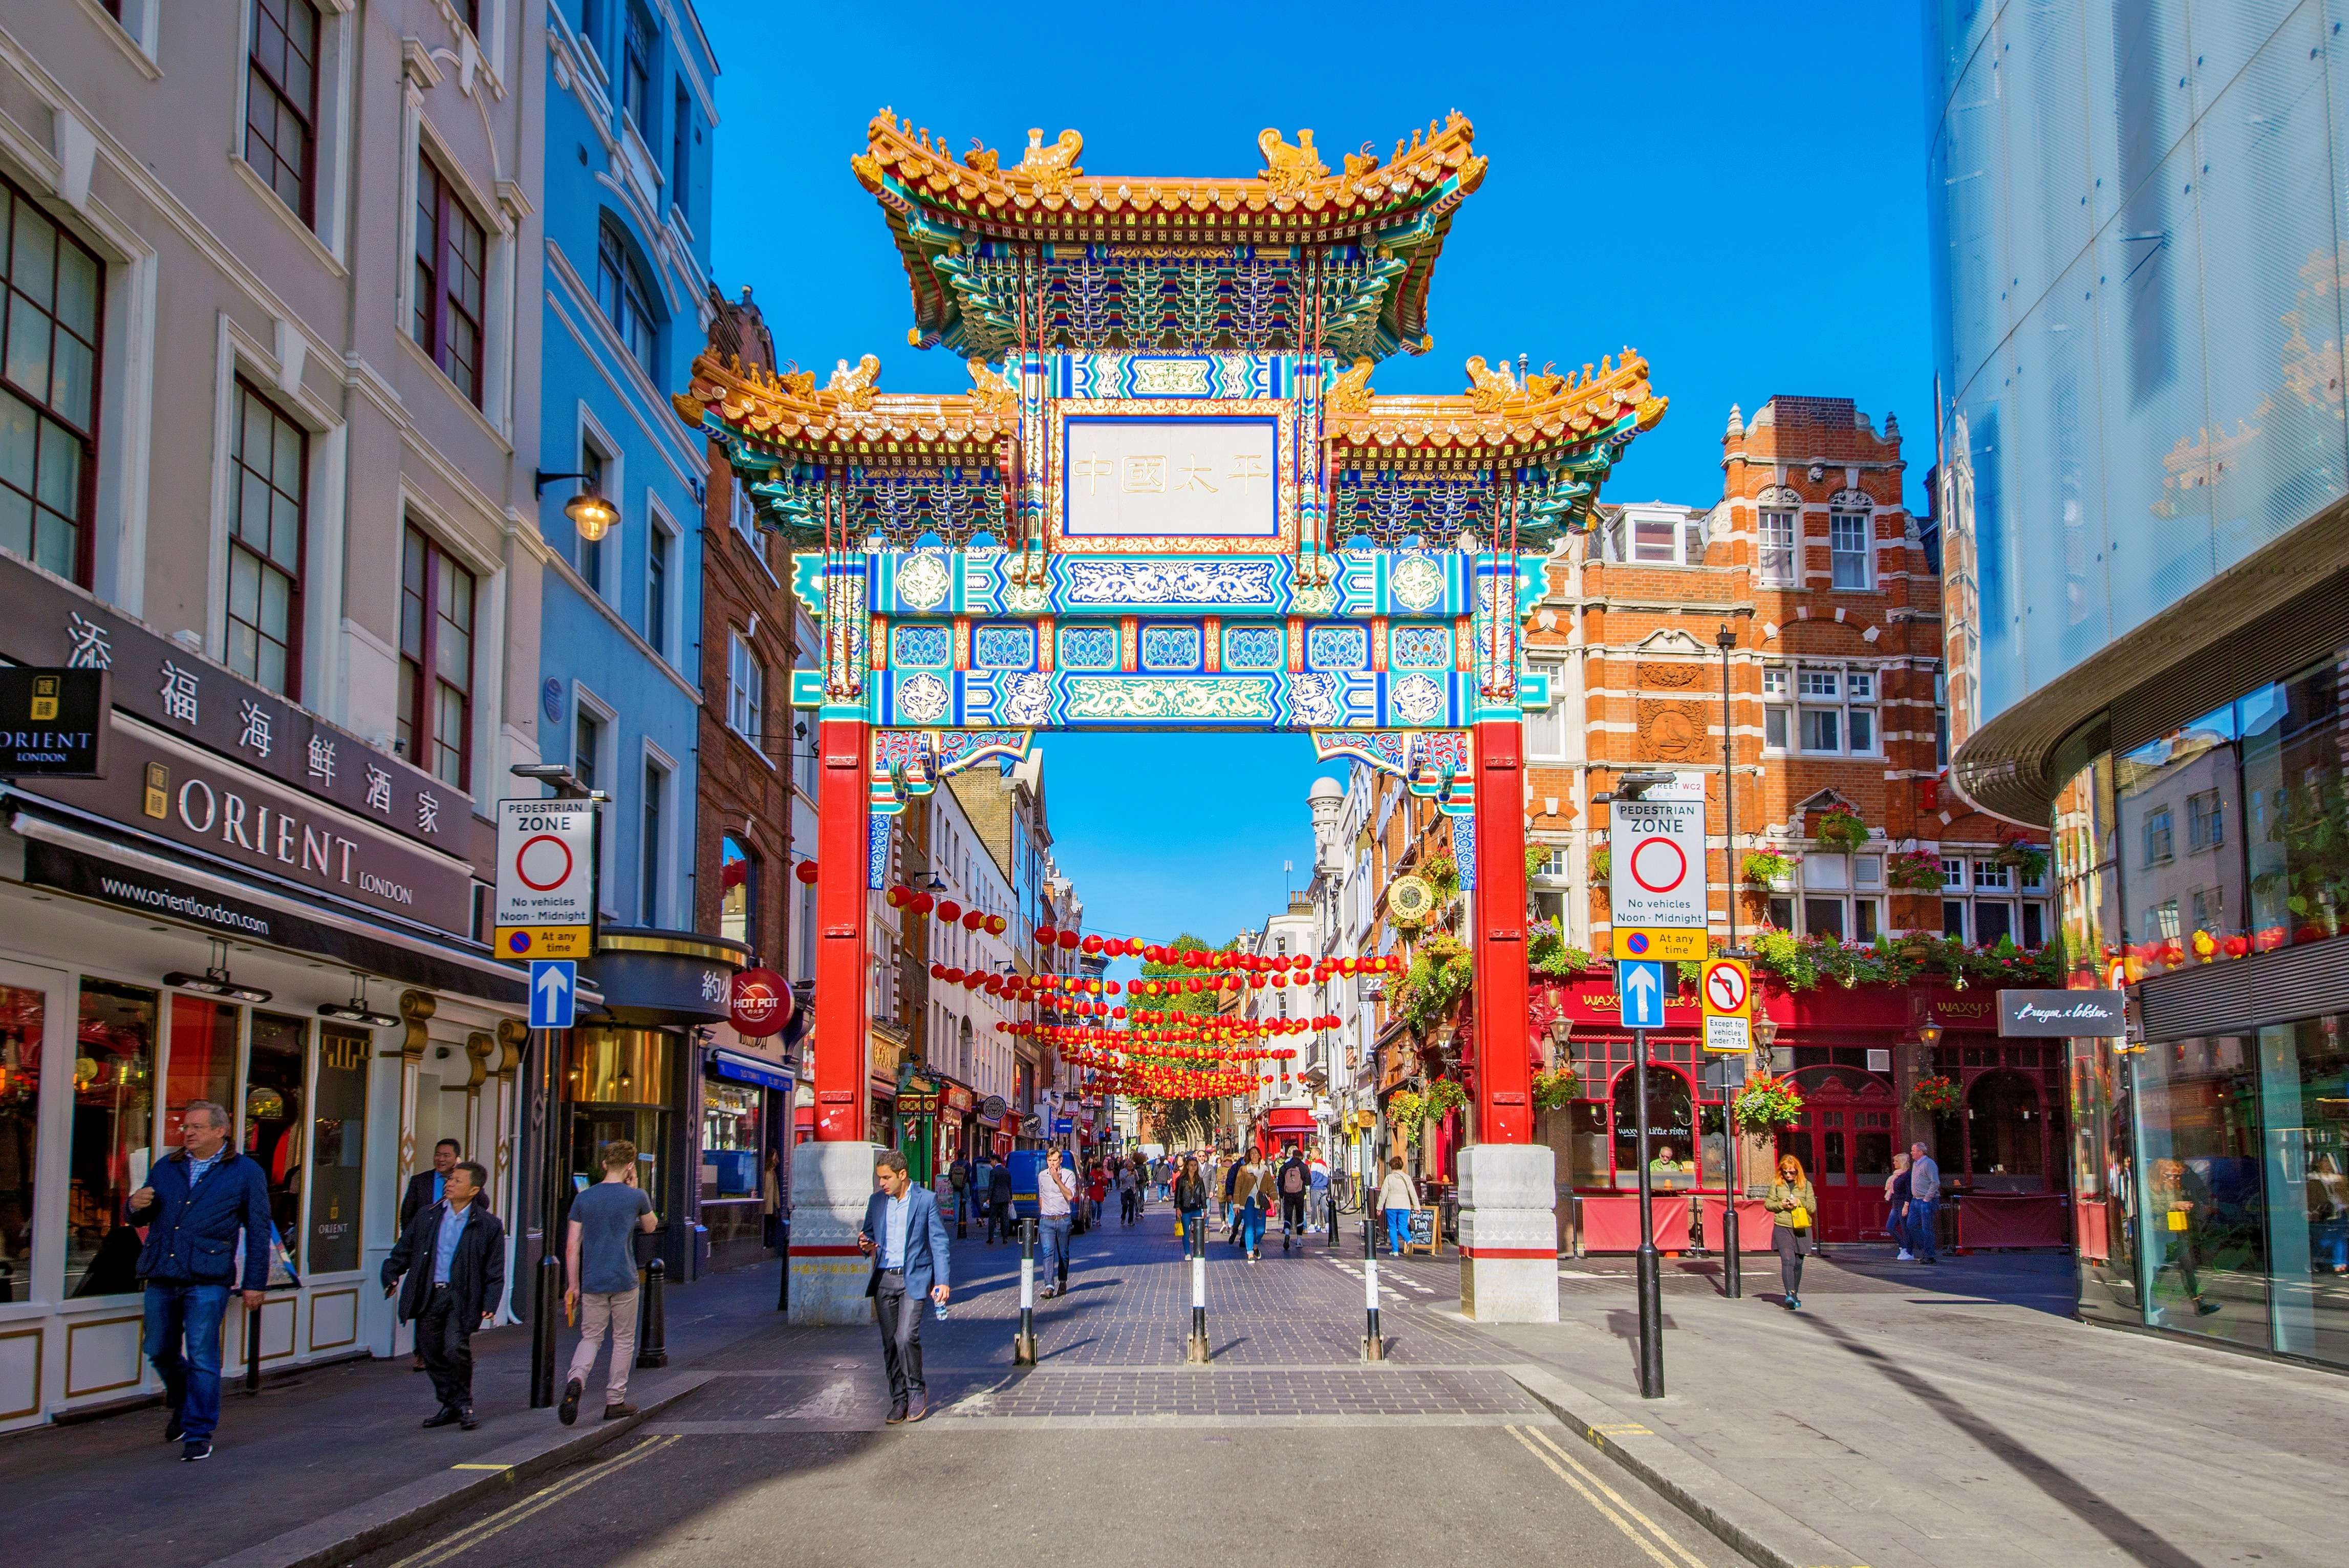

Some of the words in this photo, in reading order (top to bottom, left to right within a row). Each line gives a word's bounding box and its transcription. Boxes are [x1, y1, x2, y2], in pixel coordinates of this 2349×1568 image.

[1072, 450, 1269, 496] 中國太平
[0, 732, 92, 748] ORIENT
[17, 753, 67, 762] LONDON
[509, 803, 584, 813] PEDESTRIAN
[1620, 806, 1694, 815] PEDESTRIAN
[519, 817, 571, 831] ZONE
[1631, 820, 1684, 832] ZONE
[178, 779, 358, 886] ORIENT
[359, 871, 413, 905] LONDON
[102, 877, 269, 935] www.orientlondon.com
[512, 897, 527, 907] No
[531, 897, 575, 907] vehicles
[1628, 899, 1644, 908] No
[1647, 899, 1690, 908] vehicles
[501, 912, 529, 920] Noon
[538, 911, 586, 921] Midnight
[1618, 913, 1645, 922] Noon
[1655, 913, 1702, 923] Midnight
[542, 932, 554, 941] At
[557, 933, 576, 942] any
[1660, 934, 1671, 942] At
[1675, 936, 1694, 944] any
[547, 943, 571, 952] time
[1666, 945, 1688, 954] time
[1366, 978, 1382, 990] 22
[733, 999, 755, 1008] HOT
[758, 998, 779, 1008] POT
[1583, 995, 1621, 1009] WAX
[1710, 1019, 1732, 1028] Except
[1713, 1027, 1741, 1037] vehicles
[1710, 1036, 1730, 1045] under
[1648, 1127, 1667, 1135] Little
[318, 1222, 349, 1234] ORIENT
